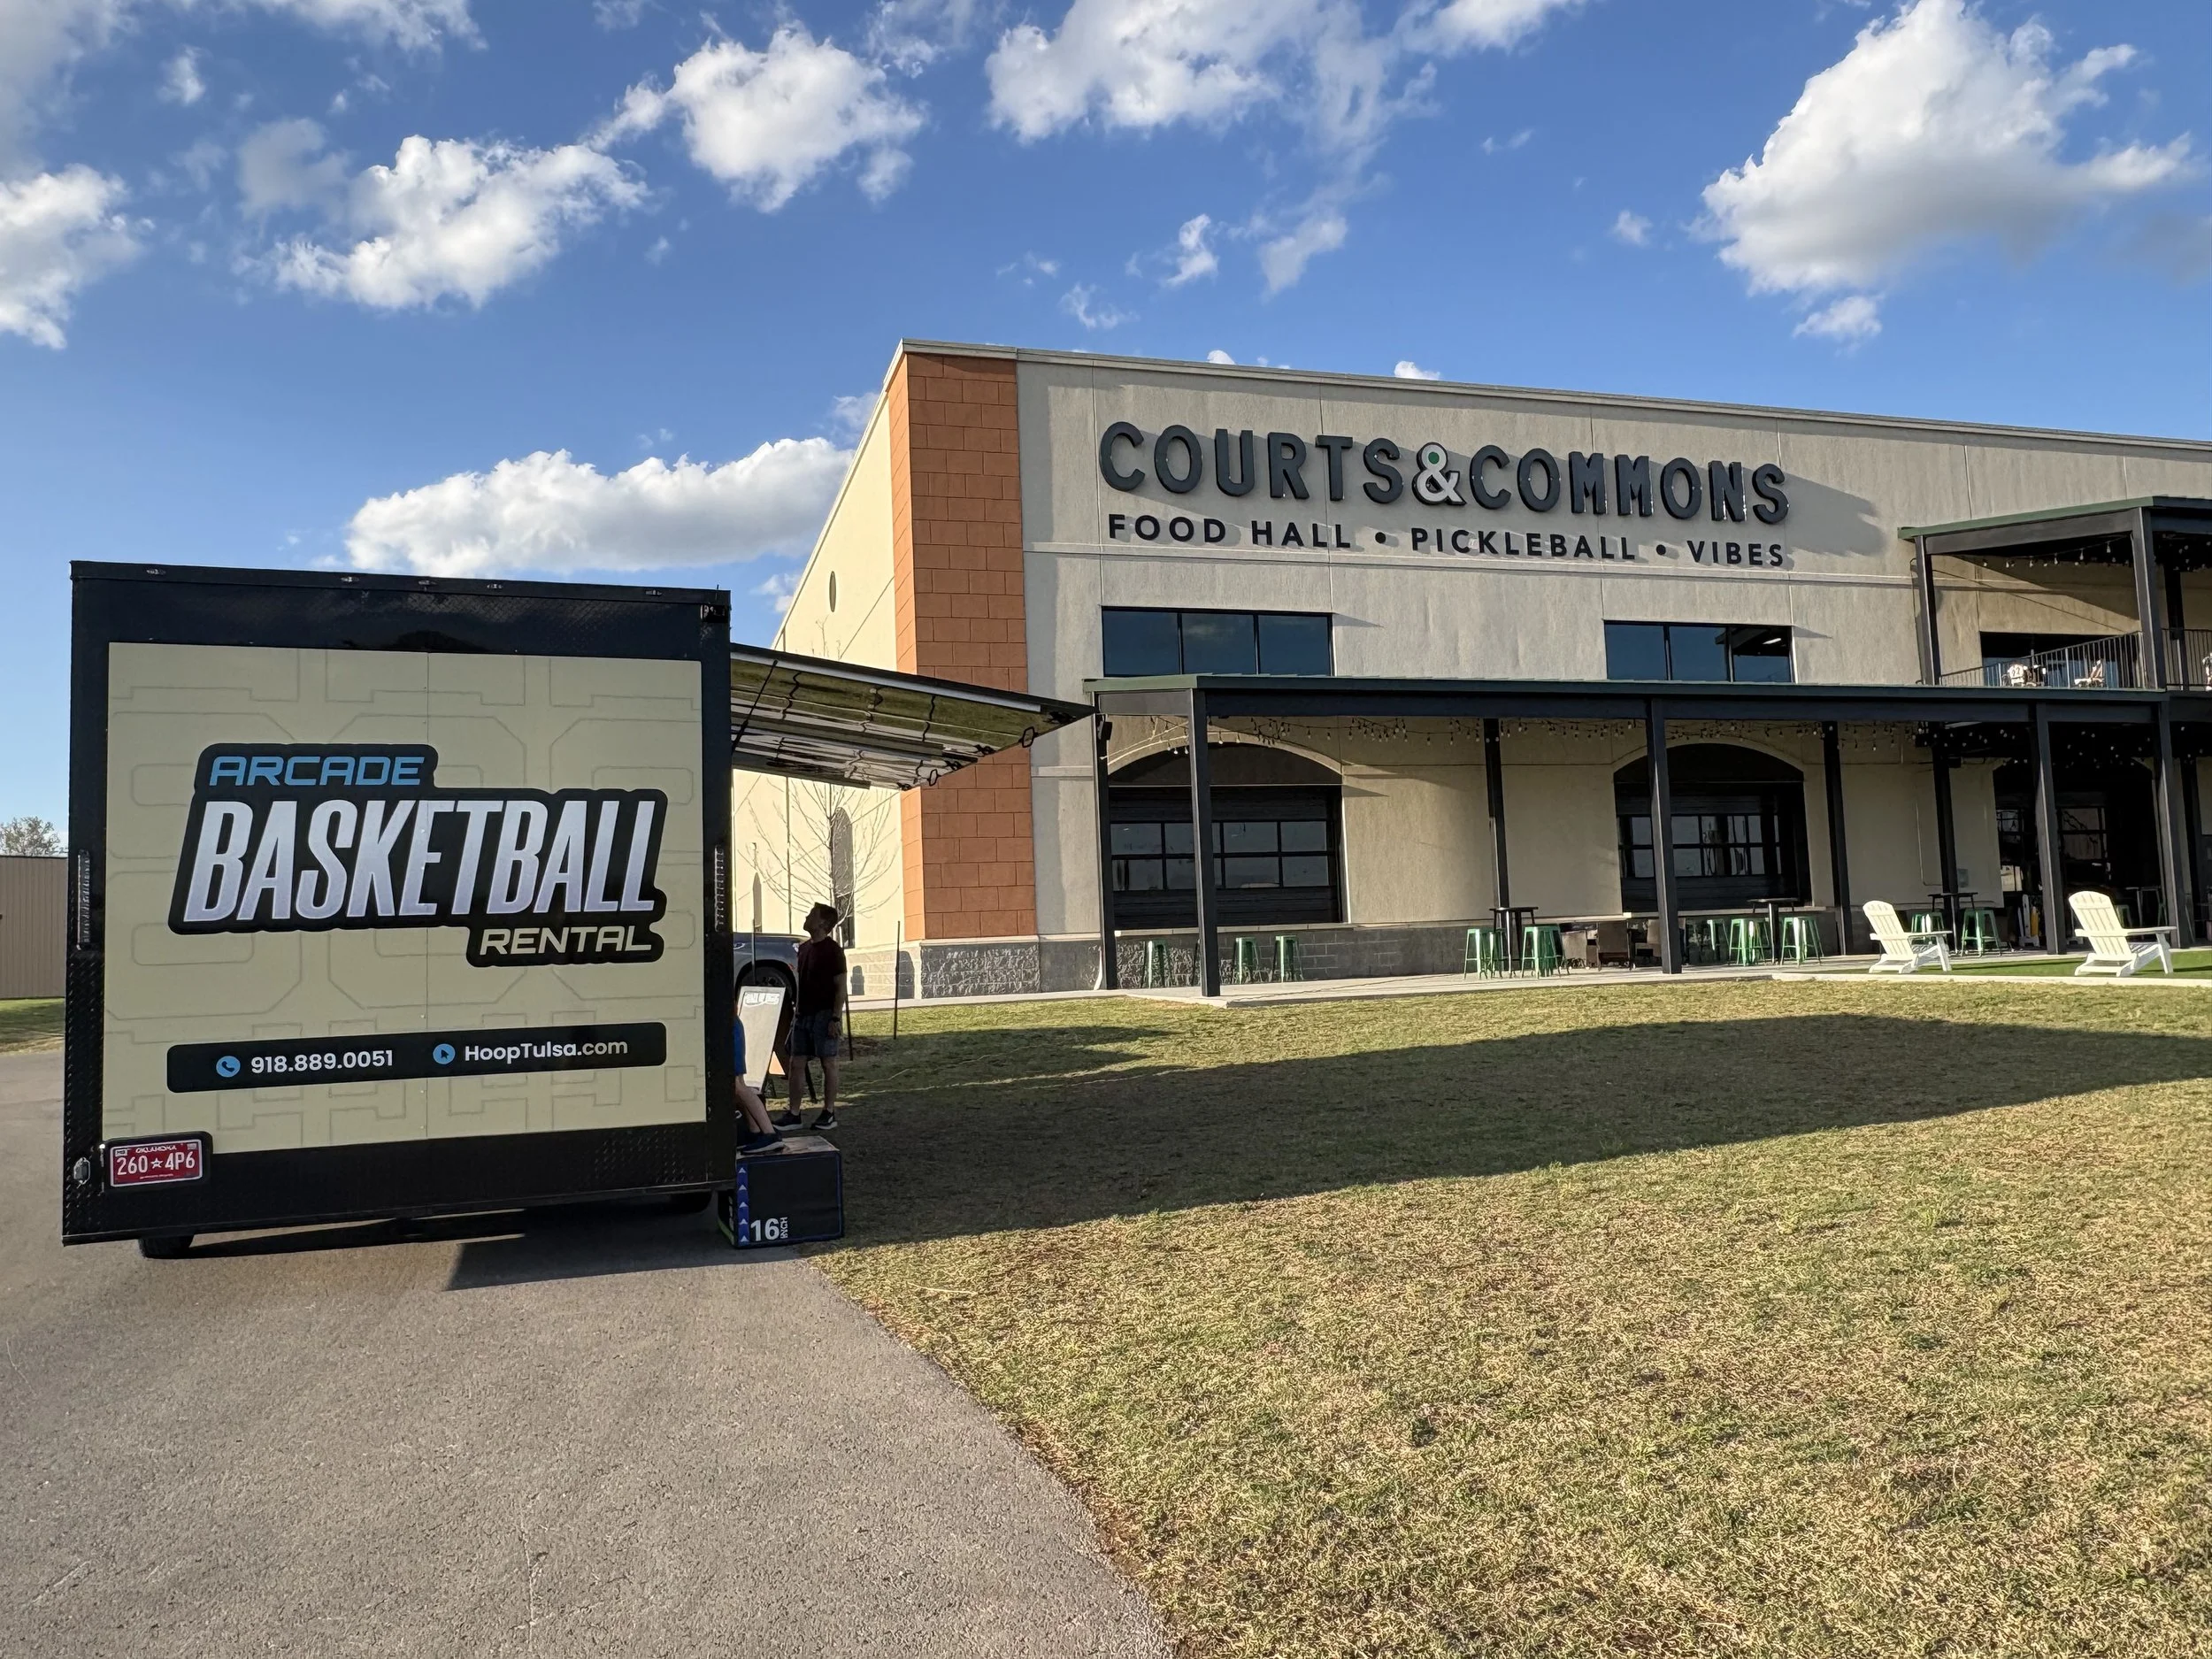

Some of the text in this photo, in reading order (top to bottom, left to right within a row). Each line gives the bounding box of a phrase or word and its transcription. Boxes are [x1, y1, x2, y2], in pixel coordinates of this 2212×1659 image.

[1109, 514, 1784, 566] FOOD HALL PICKLEBALL VIBES
[209, 757, 426, 787] ARCADE
[183, 799, 656, 923] BASKETBALL
[480, 926, 652, 956] RENTAL
[250, 1039, 628, 1074] 918.889.0051 HoopTulsa.com
[135, 1145, 177, 1154] OKLAHOMA
[750, 1217, 780, 1241] 16
